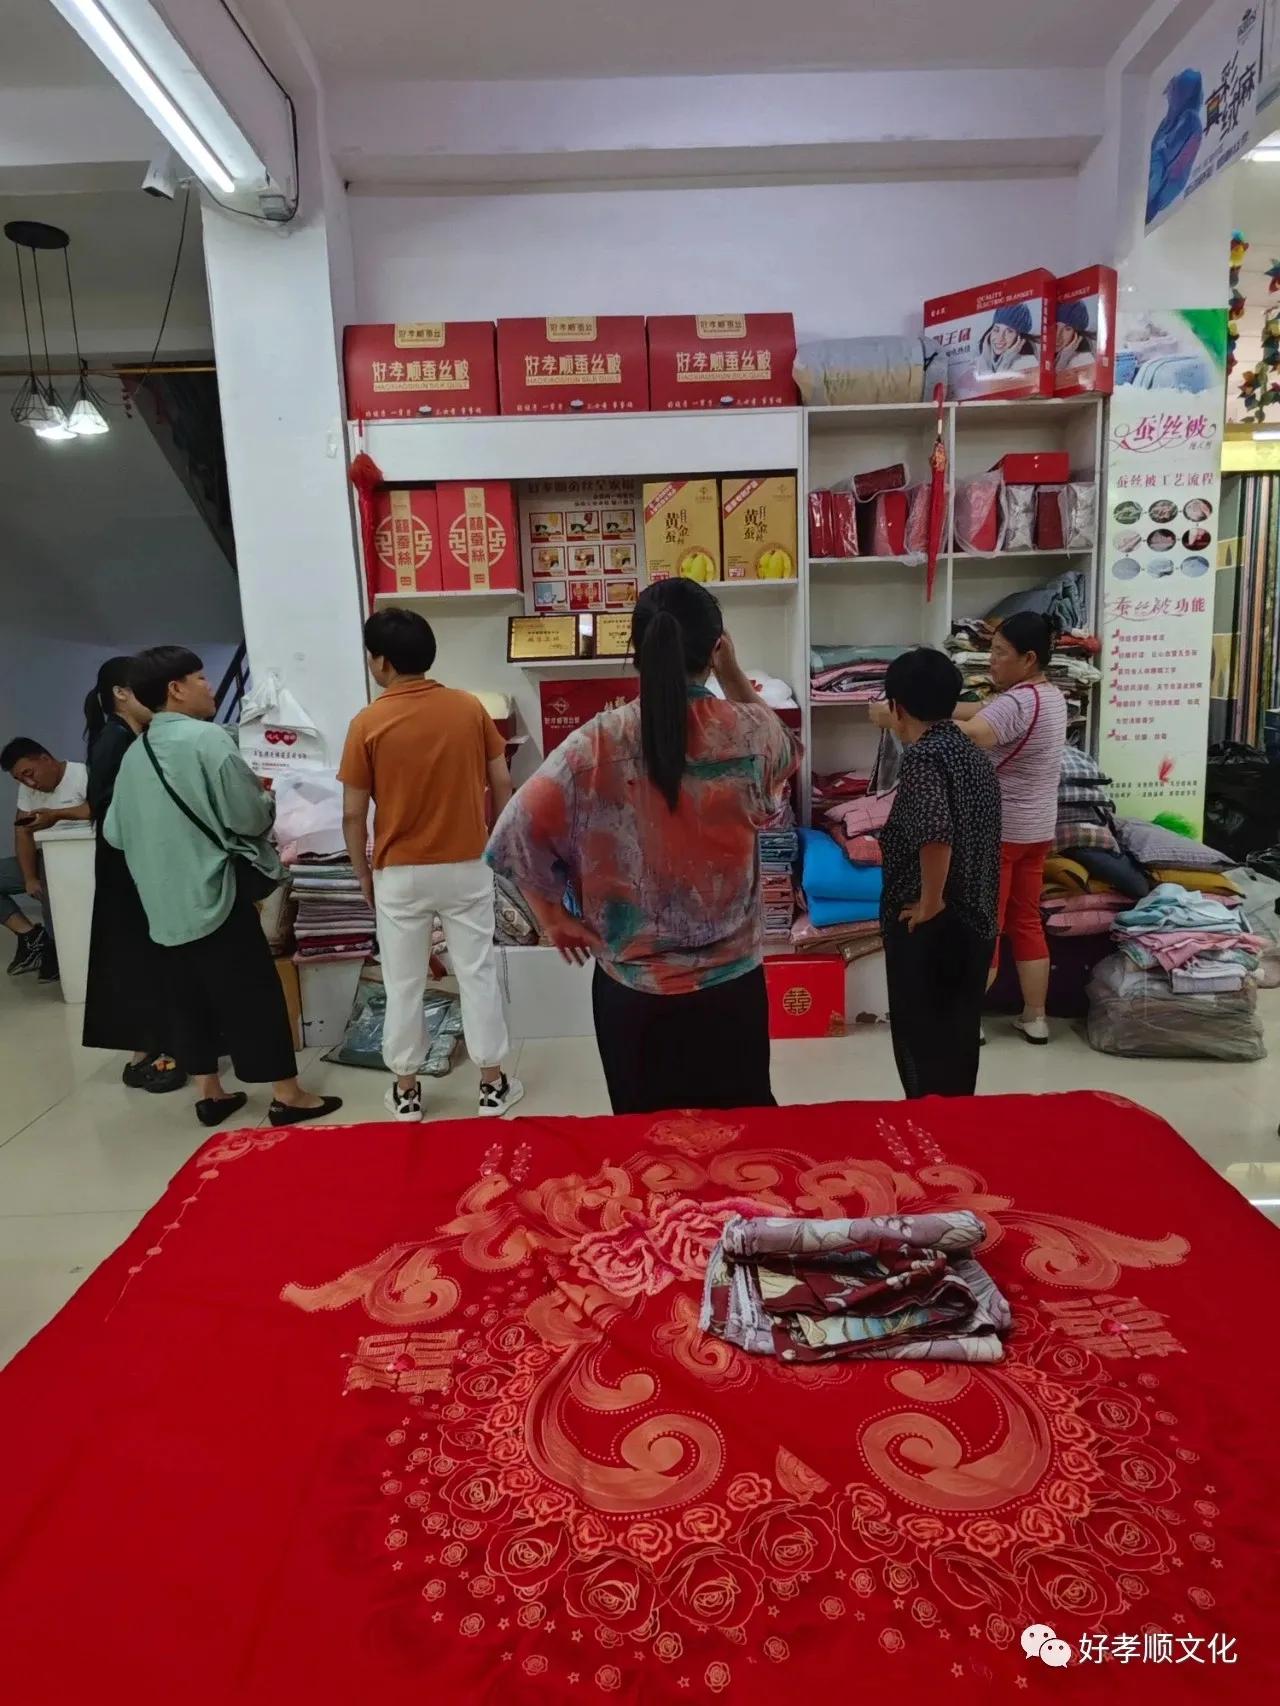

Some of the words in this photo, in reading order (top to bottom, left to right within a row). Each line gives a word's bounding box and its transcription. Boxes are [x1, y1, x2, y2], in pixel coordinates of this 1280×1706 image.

[372, 359, 469, 382] 好孝顺蚕丝被
[524, 353, 621, 376] 好孝顺蚕丝被
[676, 350, 771, 373] 好孝顺蚕丝被
[1134, 413, 1209, 442] 蚕丝被
[1117, 473, 1214, 489] 蚕丝被工艺流程
[1114, 597, 1206, 617] 蚕丝被功能
